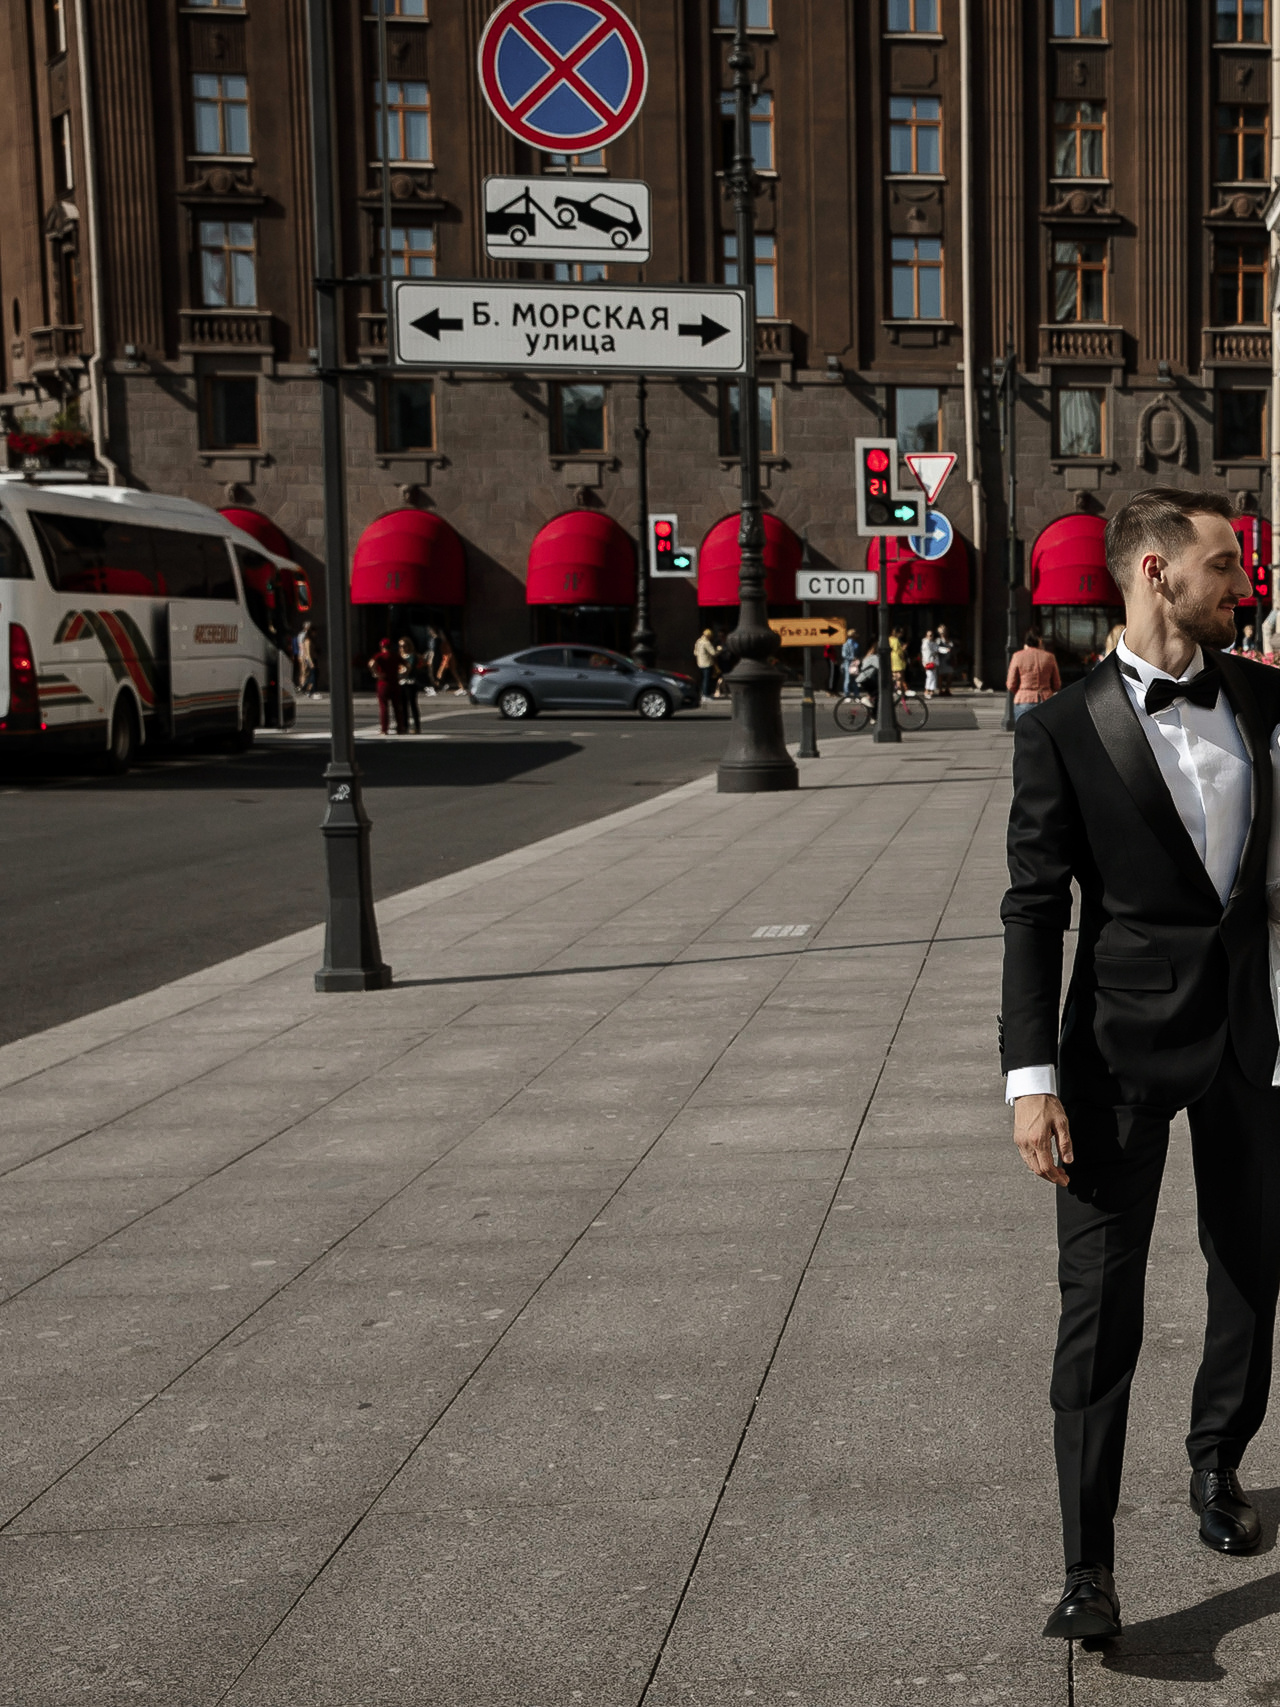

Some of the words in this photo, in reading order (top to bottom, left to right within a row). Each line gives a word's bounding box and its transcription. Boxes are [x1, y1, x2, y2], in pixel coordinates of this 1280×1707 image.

[473, 302, 500, 327] Б.
[512, 303, 669, 331] МОРСКАЯ
[525, 333, 616, 357] улица
[870, 476, 887, 496] 21
[808, 577, 865, 595] СТОП
